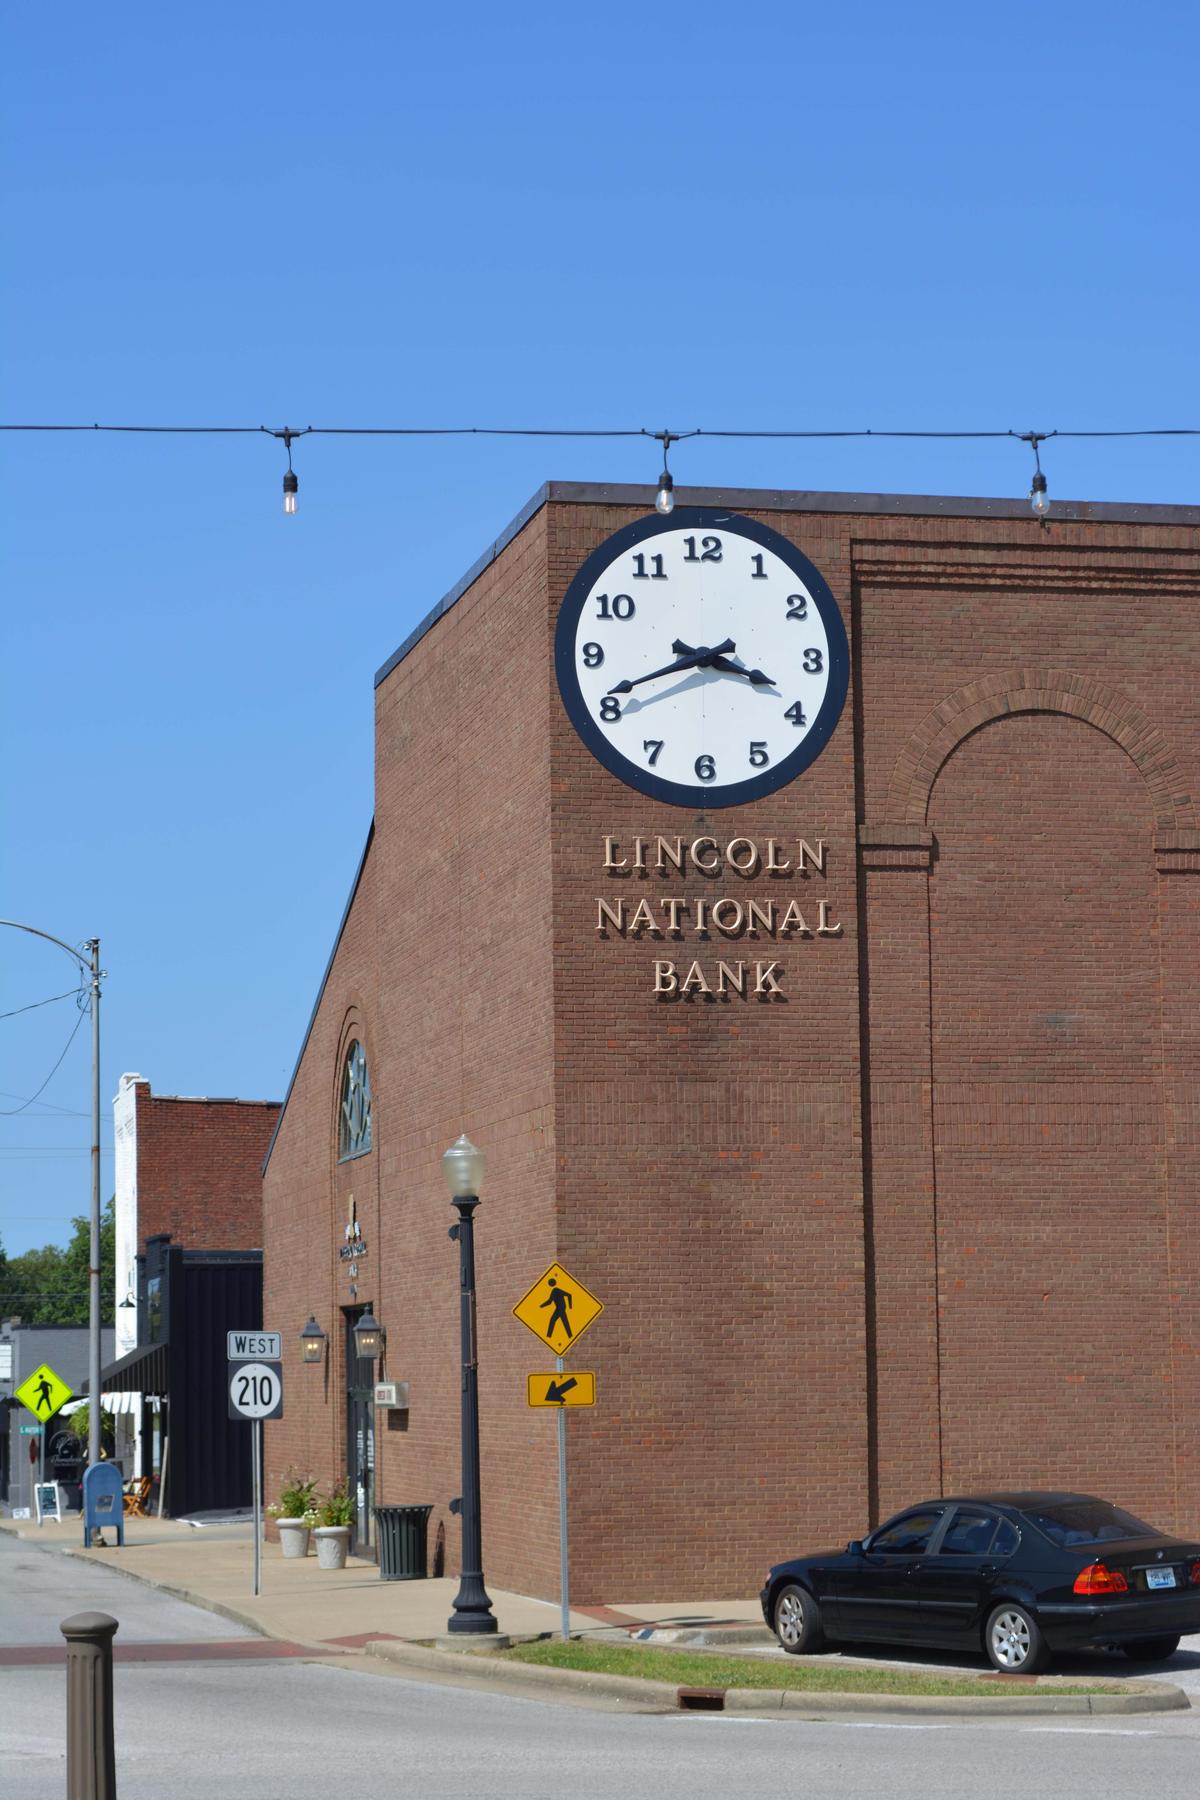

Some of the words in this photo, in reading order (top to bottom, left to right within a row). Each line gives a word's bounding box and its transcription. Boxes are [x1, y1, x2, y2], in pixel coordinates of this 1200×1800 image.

[683, 536, 723, 561] 12
[632, 553, 667, 578] 11
[751, 553, 768, 578] 1
[596, 594, 635, 619] 10
[786, 594, 807, 619] 2
[582, 642, 604, 667] 9
[803, 648, 823, 672] 3
[600, 696, 621, 721] 8
[784, 701, 806, 725] 4
[643, 740, 663, 764] 7
[749, 741, 769, 766] 5
[694, 754, 716, 779] 6
[602, 835, 827, 871] LINCOLN
[594, 898, 842, 932] NATIONAL
[651, 960, 784, 992] BANK
[234, 1335, 276, 1354] WEST
[237, 1376, 273, 1406] 210
